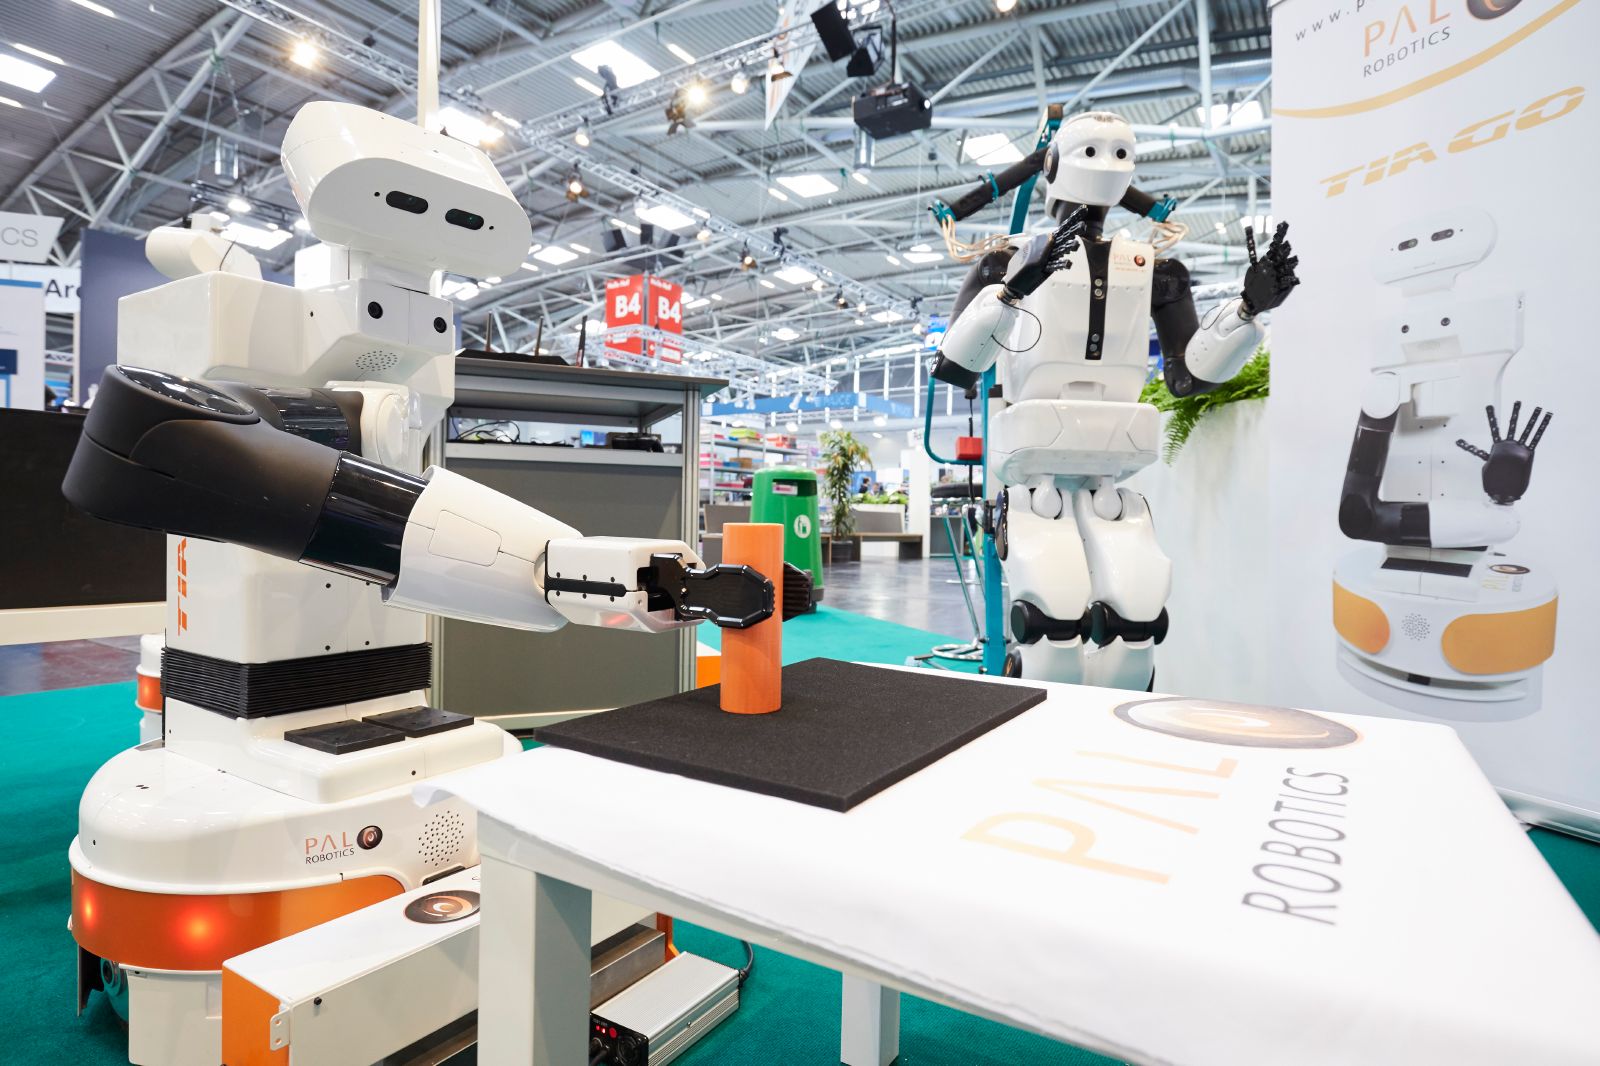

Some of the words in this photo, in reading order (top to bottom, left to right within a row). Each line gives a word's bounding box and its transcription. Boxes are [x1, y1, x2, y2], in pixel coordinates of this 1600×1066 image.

[1363, 26, 1451, 78] ROBOTICS
[615, 292, 641, 318] B4
[657, 295, 681, 324] B4
[959, 748, 1240, 886] PAL
[304, 831, 354, 855] PAL
[304, 847, 355, 865] ROBOTICS
[1240, 766, 1351, 927] ROBOTICS
